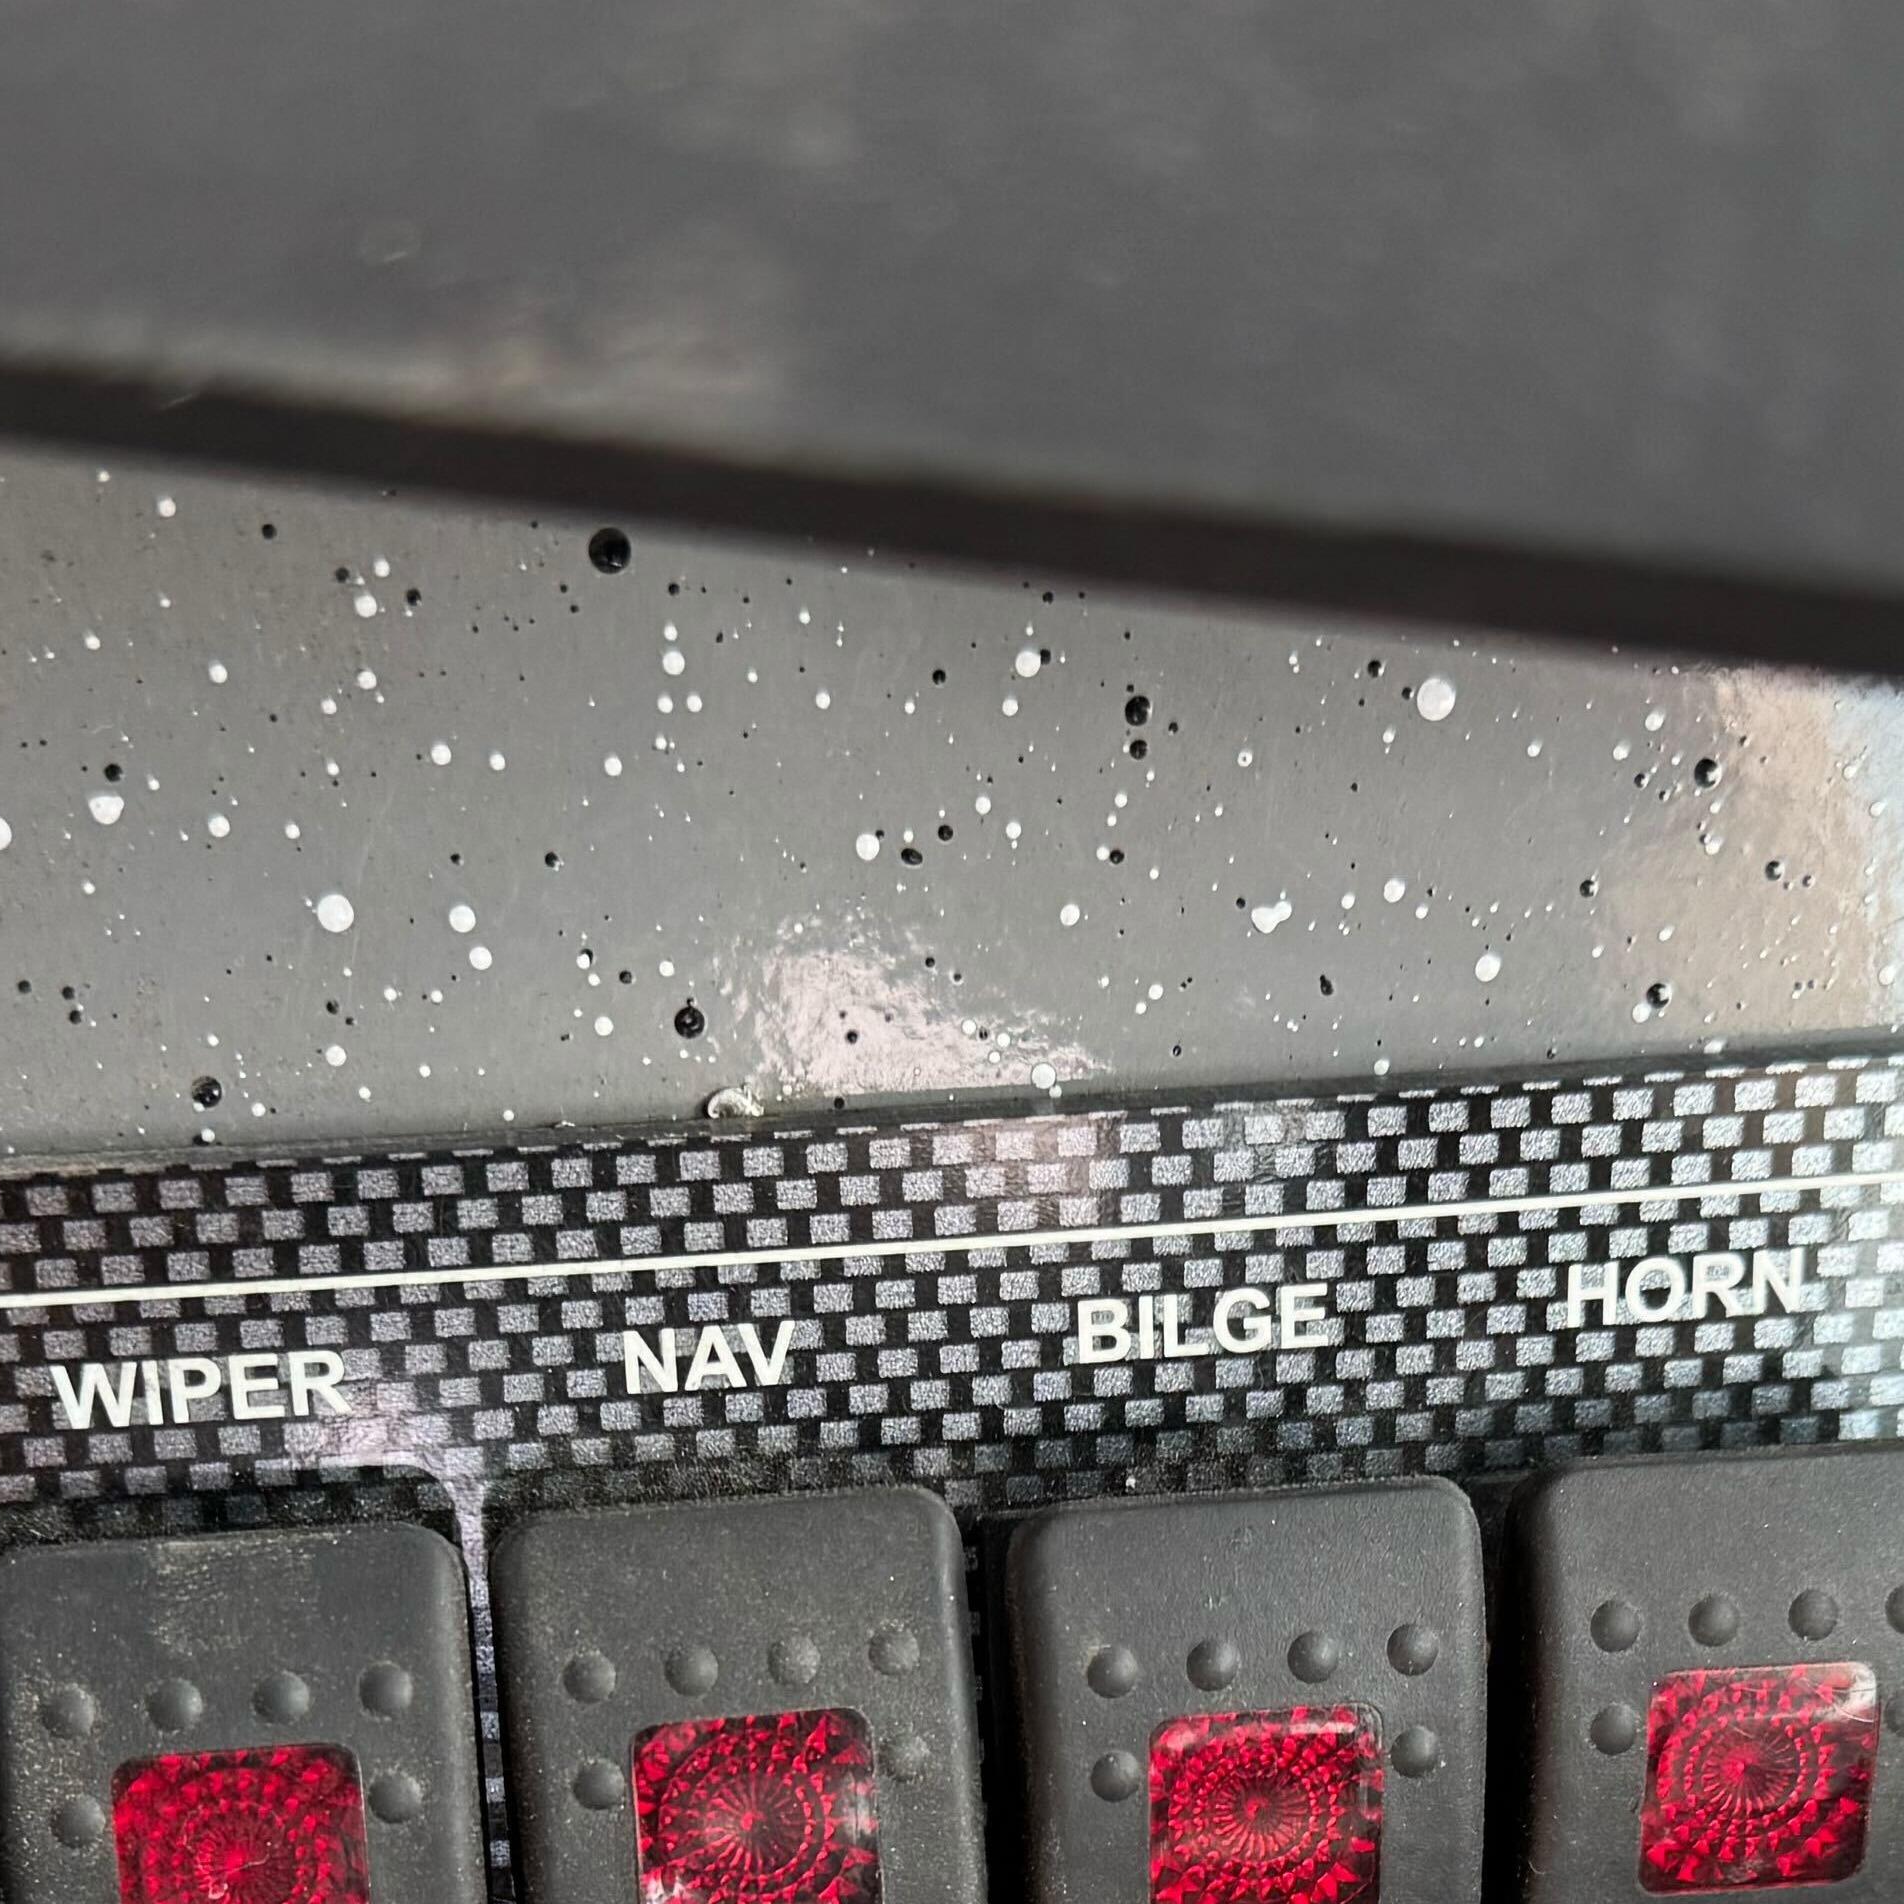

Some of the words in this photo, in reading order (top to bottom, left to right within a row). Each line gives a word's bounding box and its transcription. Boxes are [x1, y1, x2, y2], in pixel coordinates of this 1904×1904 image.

[1077, 1282, 1330, 1364] BILGE
[1566, 1247, 1807, 1328] HORN
[50, 1350, 353, 1430] WIPER
[622, 1320, 796, 1395] NAV
